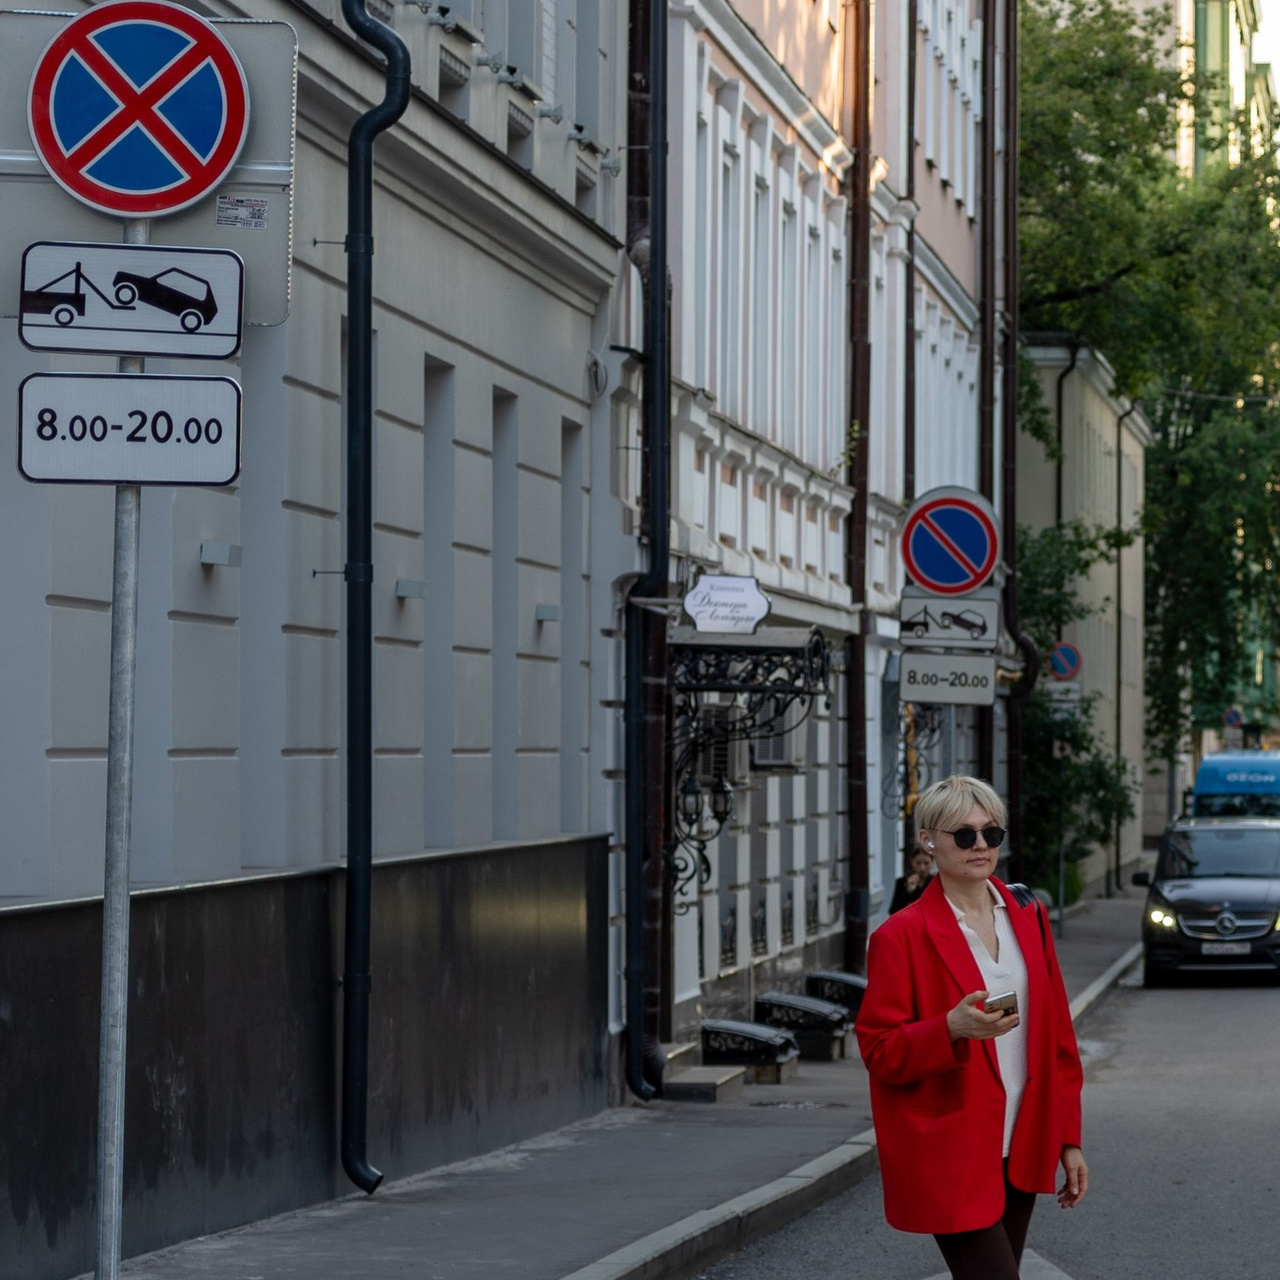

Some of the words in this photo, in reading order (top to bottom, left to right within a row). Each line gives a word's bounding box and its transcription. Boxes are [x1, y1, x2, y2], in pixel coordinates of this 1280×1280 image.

[36, 407, 223, 444] 8.00-20.00
[709, 583, 745, 593] Клиника
[907, 669, 989, 689] 8.00-20.00
